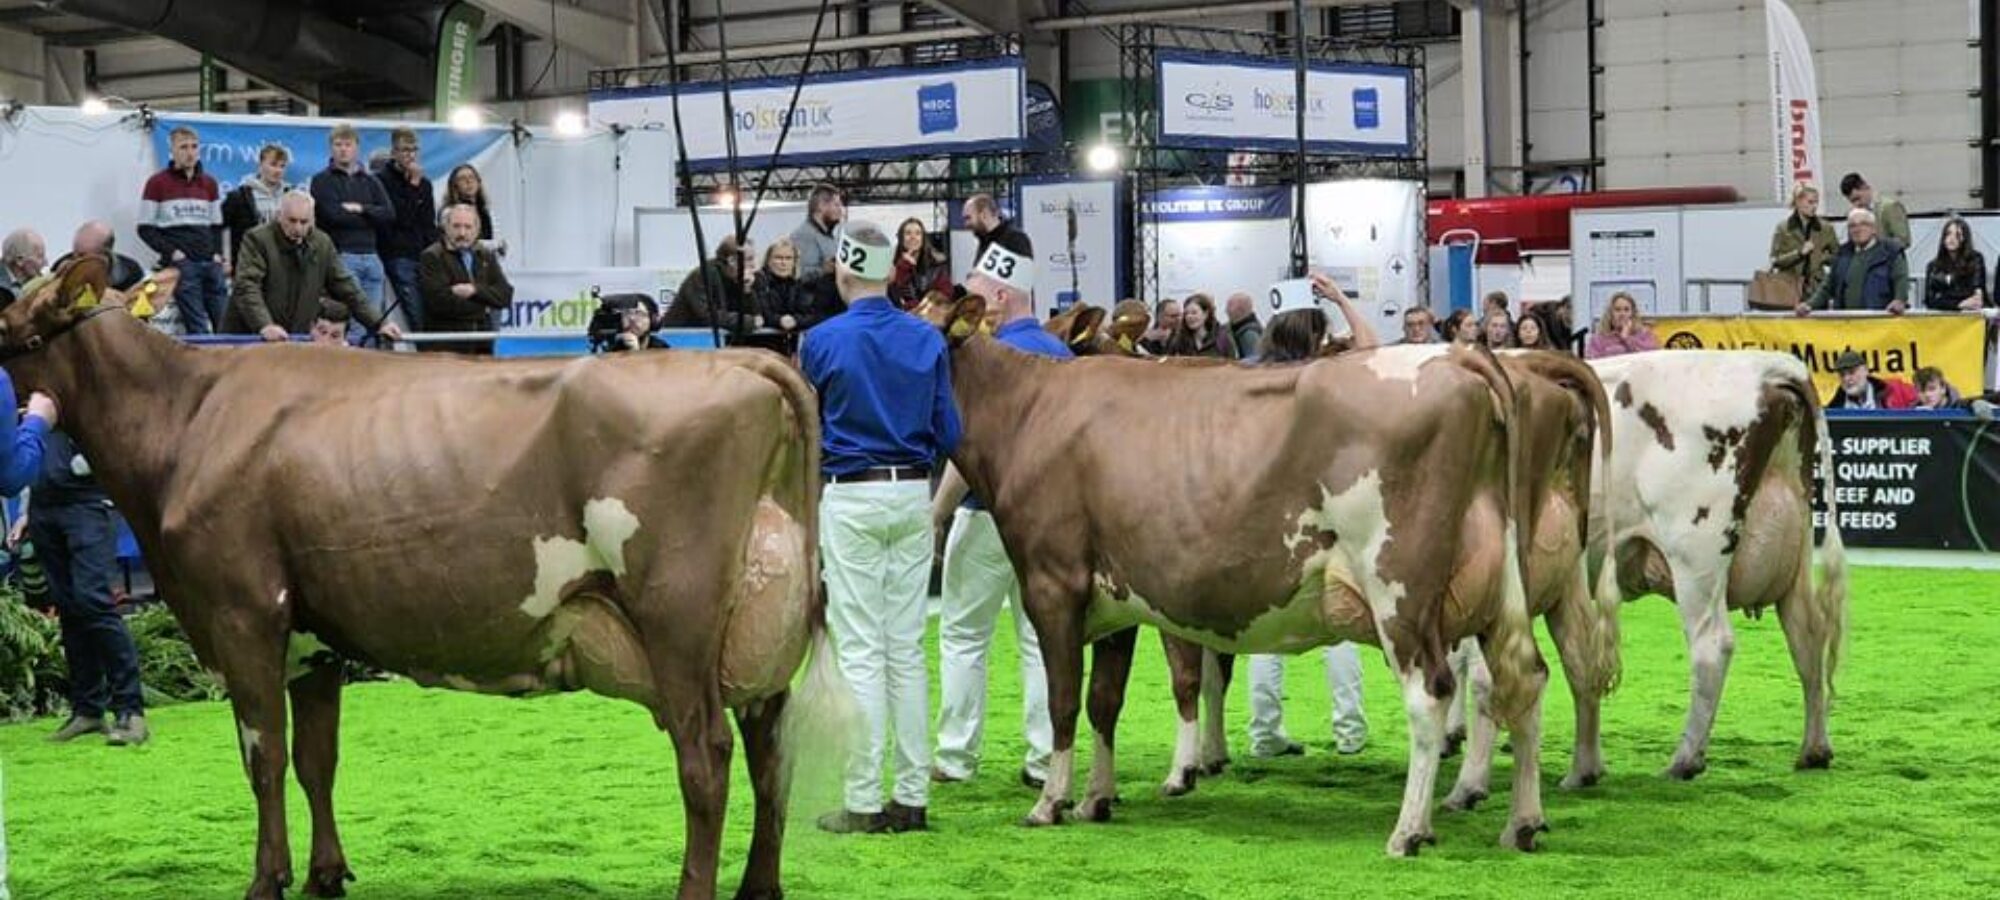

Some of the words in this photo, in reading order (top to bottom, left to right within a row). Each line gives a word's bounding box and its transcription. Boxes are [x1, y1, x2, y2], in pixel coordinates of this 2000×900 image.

[839, 241, 867, 273] 52
[984, 250, 1016, 279] 53
[1791, 340, 1918, 374] Muual
[1841, 437, 1931, 455] SUPPLIER
[1838, 462, 1918, 481] QUALITY
[1873, 487, 1915, 504] AND
[1840, 512, 1897, 529] FEEDS
